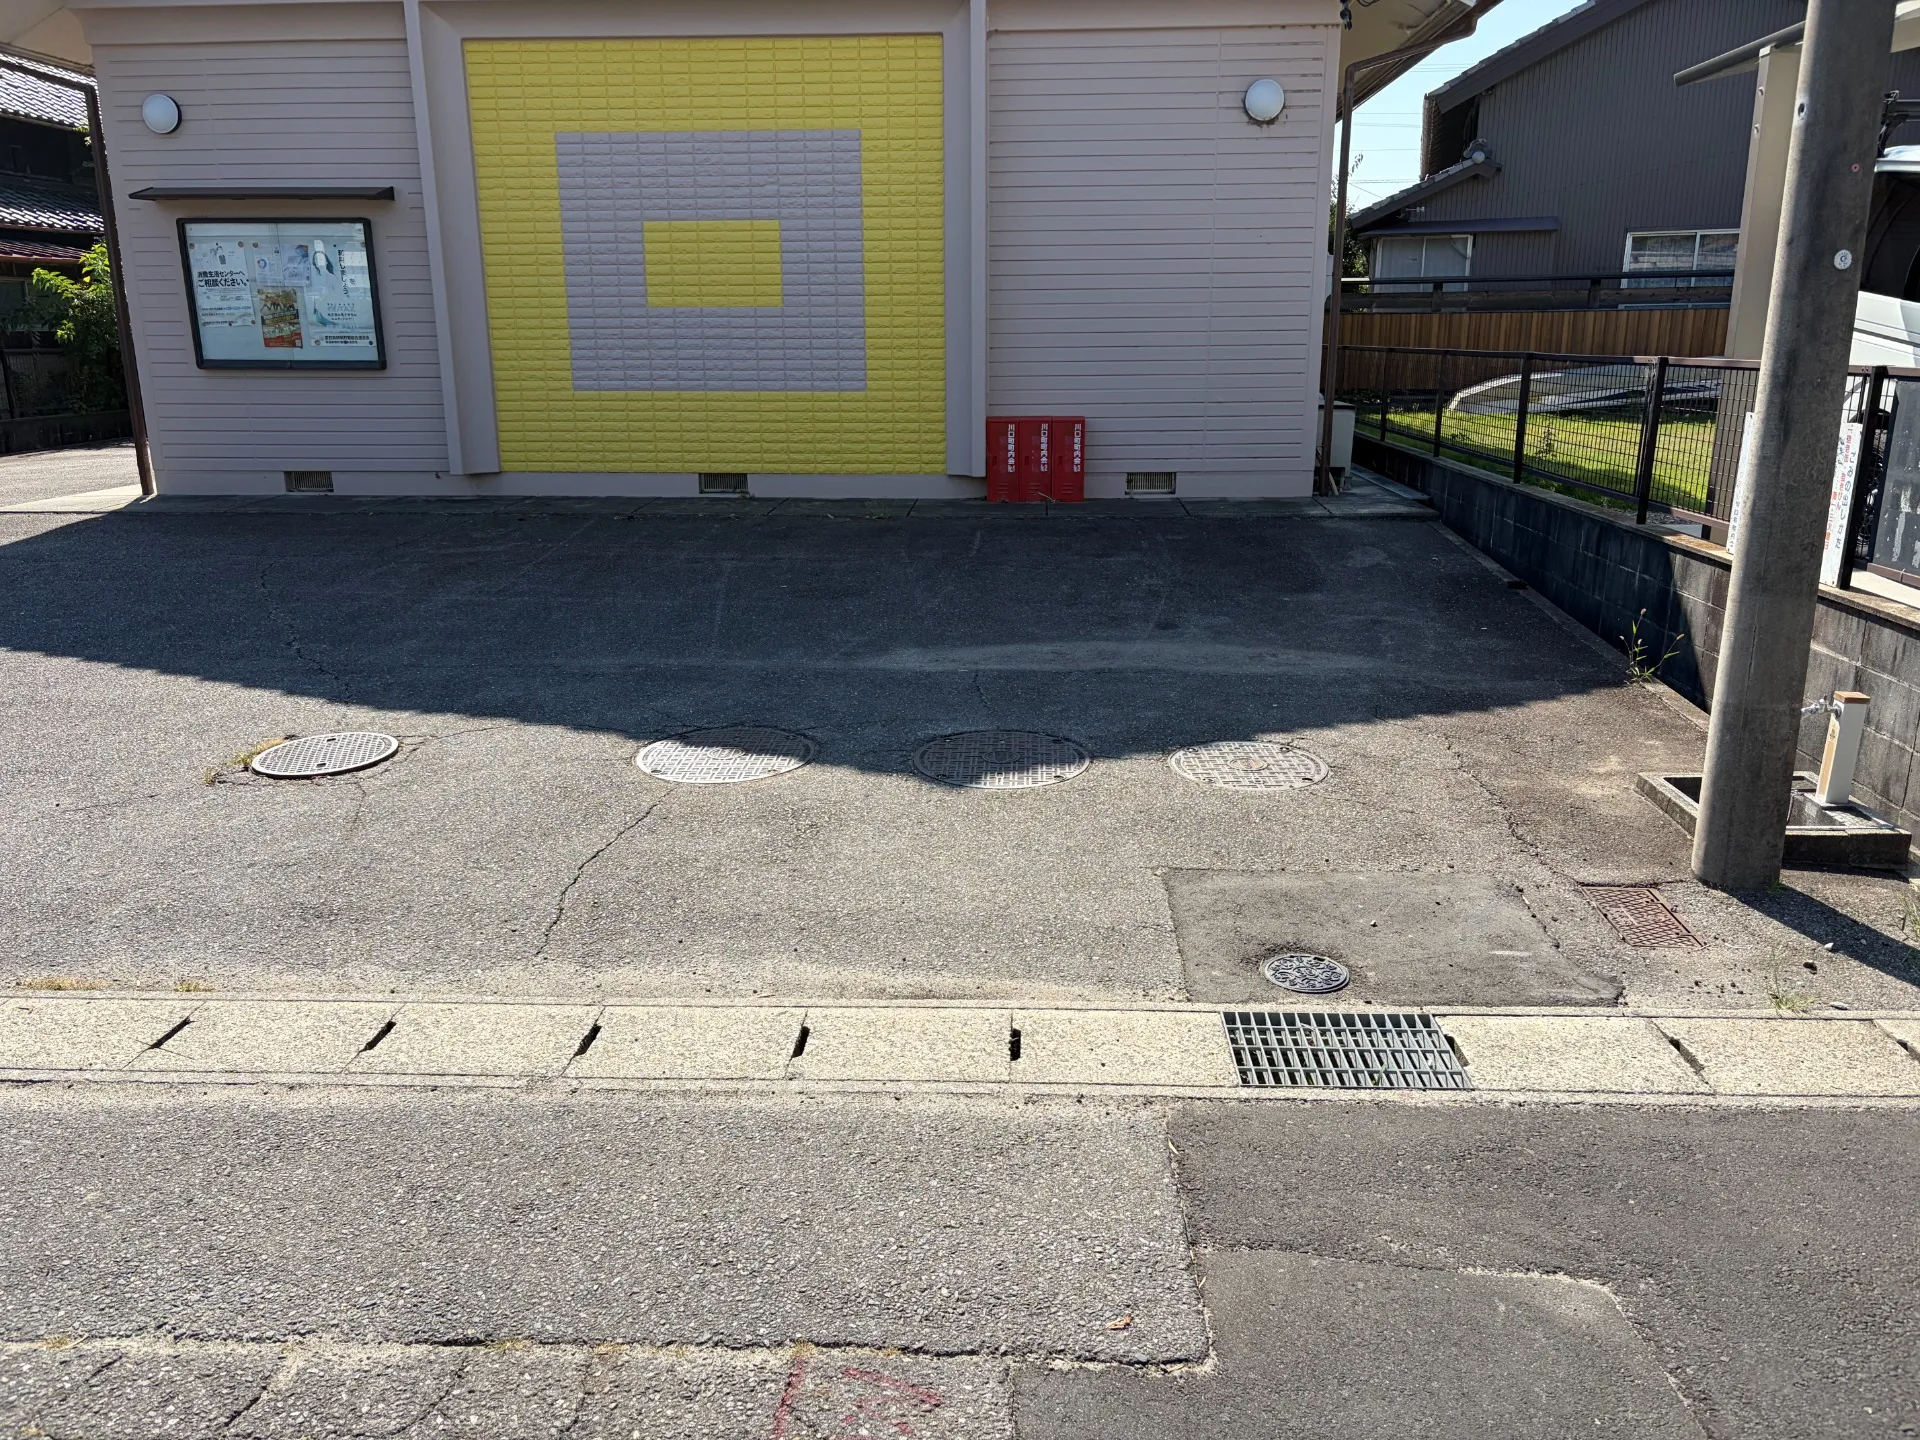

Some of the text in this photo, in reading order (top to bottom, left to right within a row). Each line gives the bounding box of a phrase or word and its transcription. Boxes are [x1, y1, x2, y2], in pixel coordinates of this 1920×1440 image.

[197, 270, 246, 278] 消費生活センターへ
[198, 279, 247, 288] ご相談ください。
